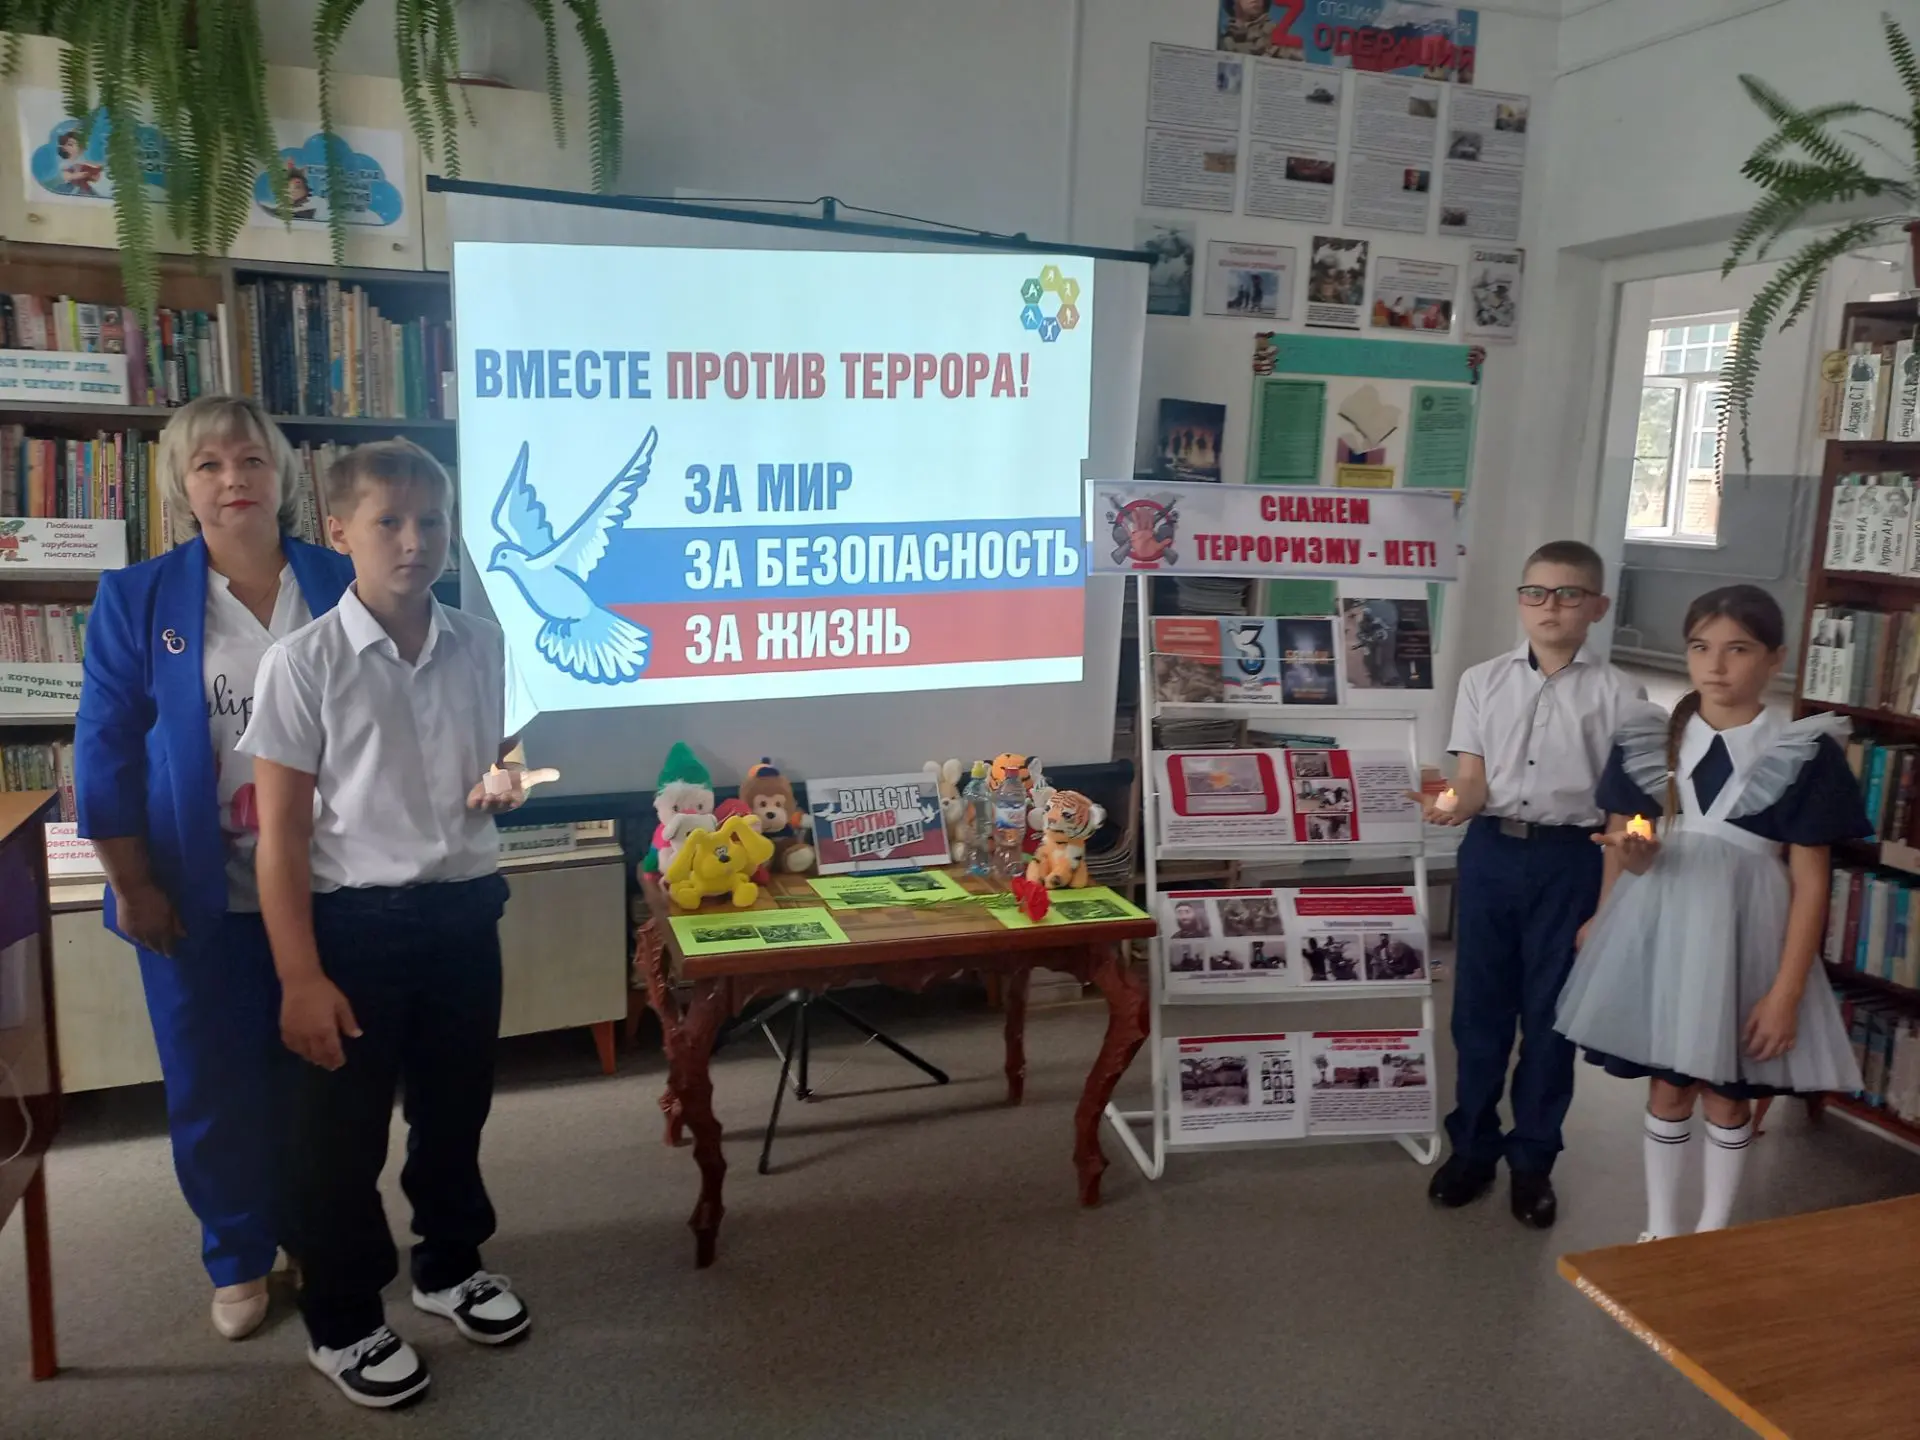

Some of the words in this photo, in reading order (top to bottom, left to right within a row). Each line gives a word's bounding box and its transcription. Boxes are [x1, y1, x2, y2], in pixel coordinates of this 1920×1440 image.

[1271, 0, 1305, 48] Z
[475, 348, 652, 399] ВМЕСТЕ
[667, 351, 826, 400] ПРОТИВ
[840, 352, 1031, 399] ТЕРРОРА!
[685, 463, 743, 515] ЗА
[756, 462, 853, 513] МИР
[46, 521, 94, 530] Любимые
[1260, 495, 1371, 525] СКАЖЕМ
[41, 541, 99, 550] зарубежных
[44, 550, 96, 559] писателей
[684, 538, 744, 591] ЗА
[756, 528, 1081, 588] БЕЗОПАСНОСТЬ
[1193, 534, 1362, 565] ТЕРРОРИЗМУ
[1384, 539, 1438, 567] НЕТ!
[685, 612, 744, 665] ЗА
[756, 607, 912, 662] ЖИЗНЬ
[8, 673, 63, 686] которые
[27, 688, 81, 700] родител
[839, 784, 921, 814] ВМЕСТЕ
[834, 808, 898, 841] ПРОТИВ
[848, 821, 923, 856] ТЕРРОРА!
[47, 851, 97, 860] исателей
